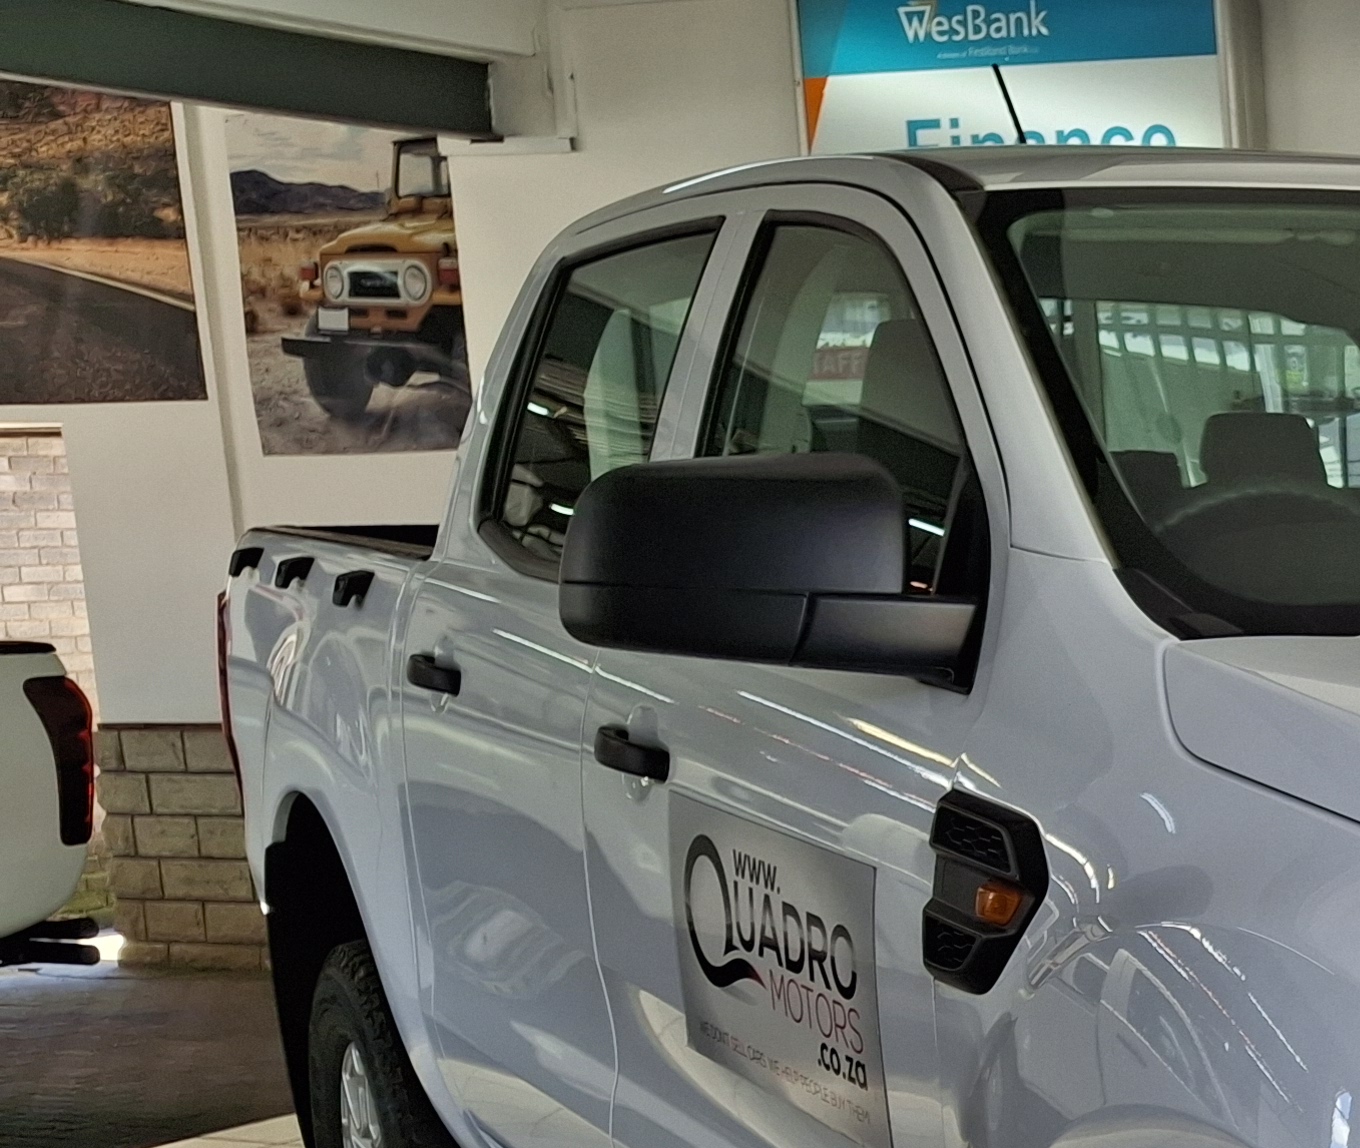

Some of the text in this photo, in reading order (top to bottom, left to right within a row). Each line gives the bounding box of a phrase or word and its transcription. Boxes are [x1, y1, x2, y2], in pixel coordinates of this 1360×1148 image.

[897, 0, 1050, 44] WesBank
[684, 834, 857, 1000] QUADRO
[768, 969, 866, 1055] MOTORS
